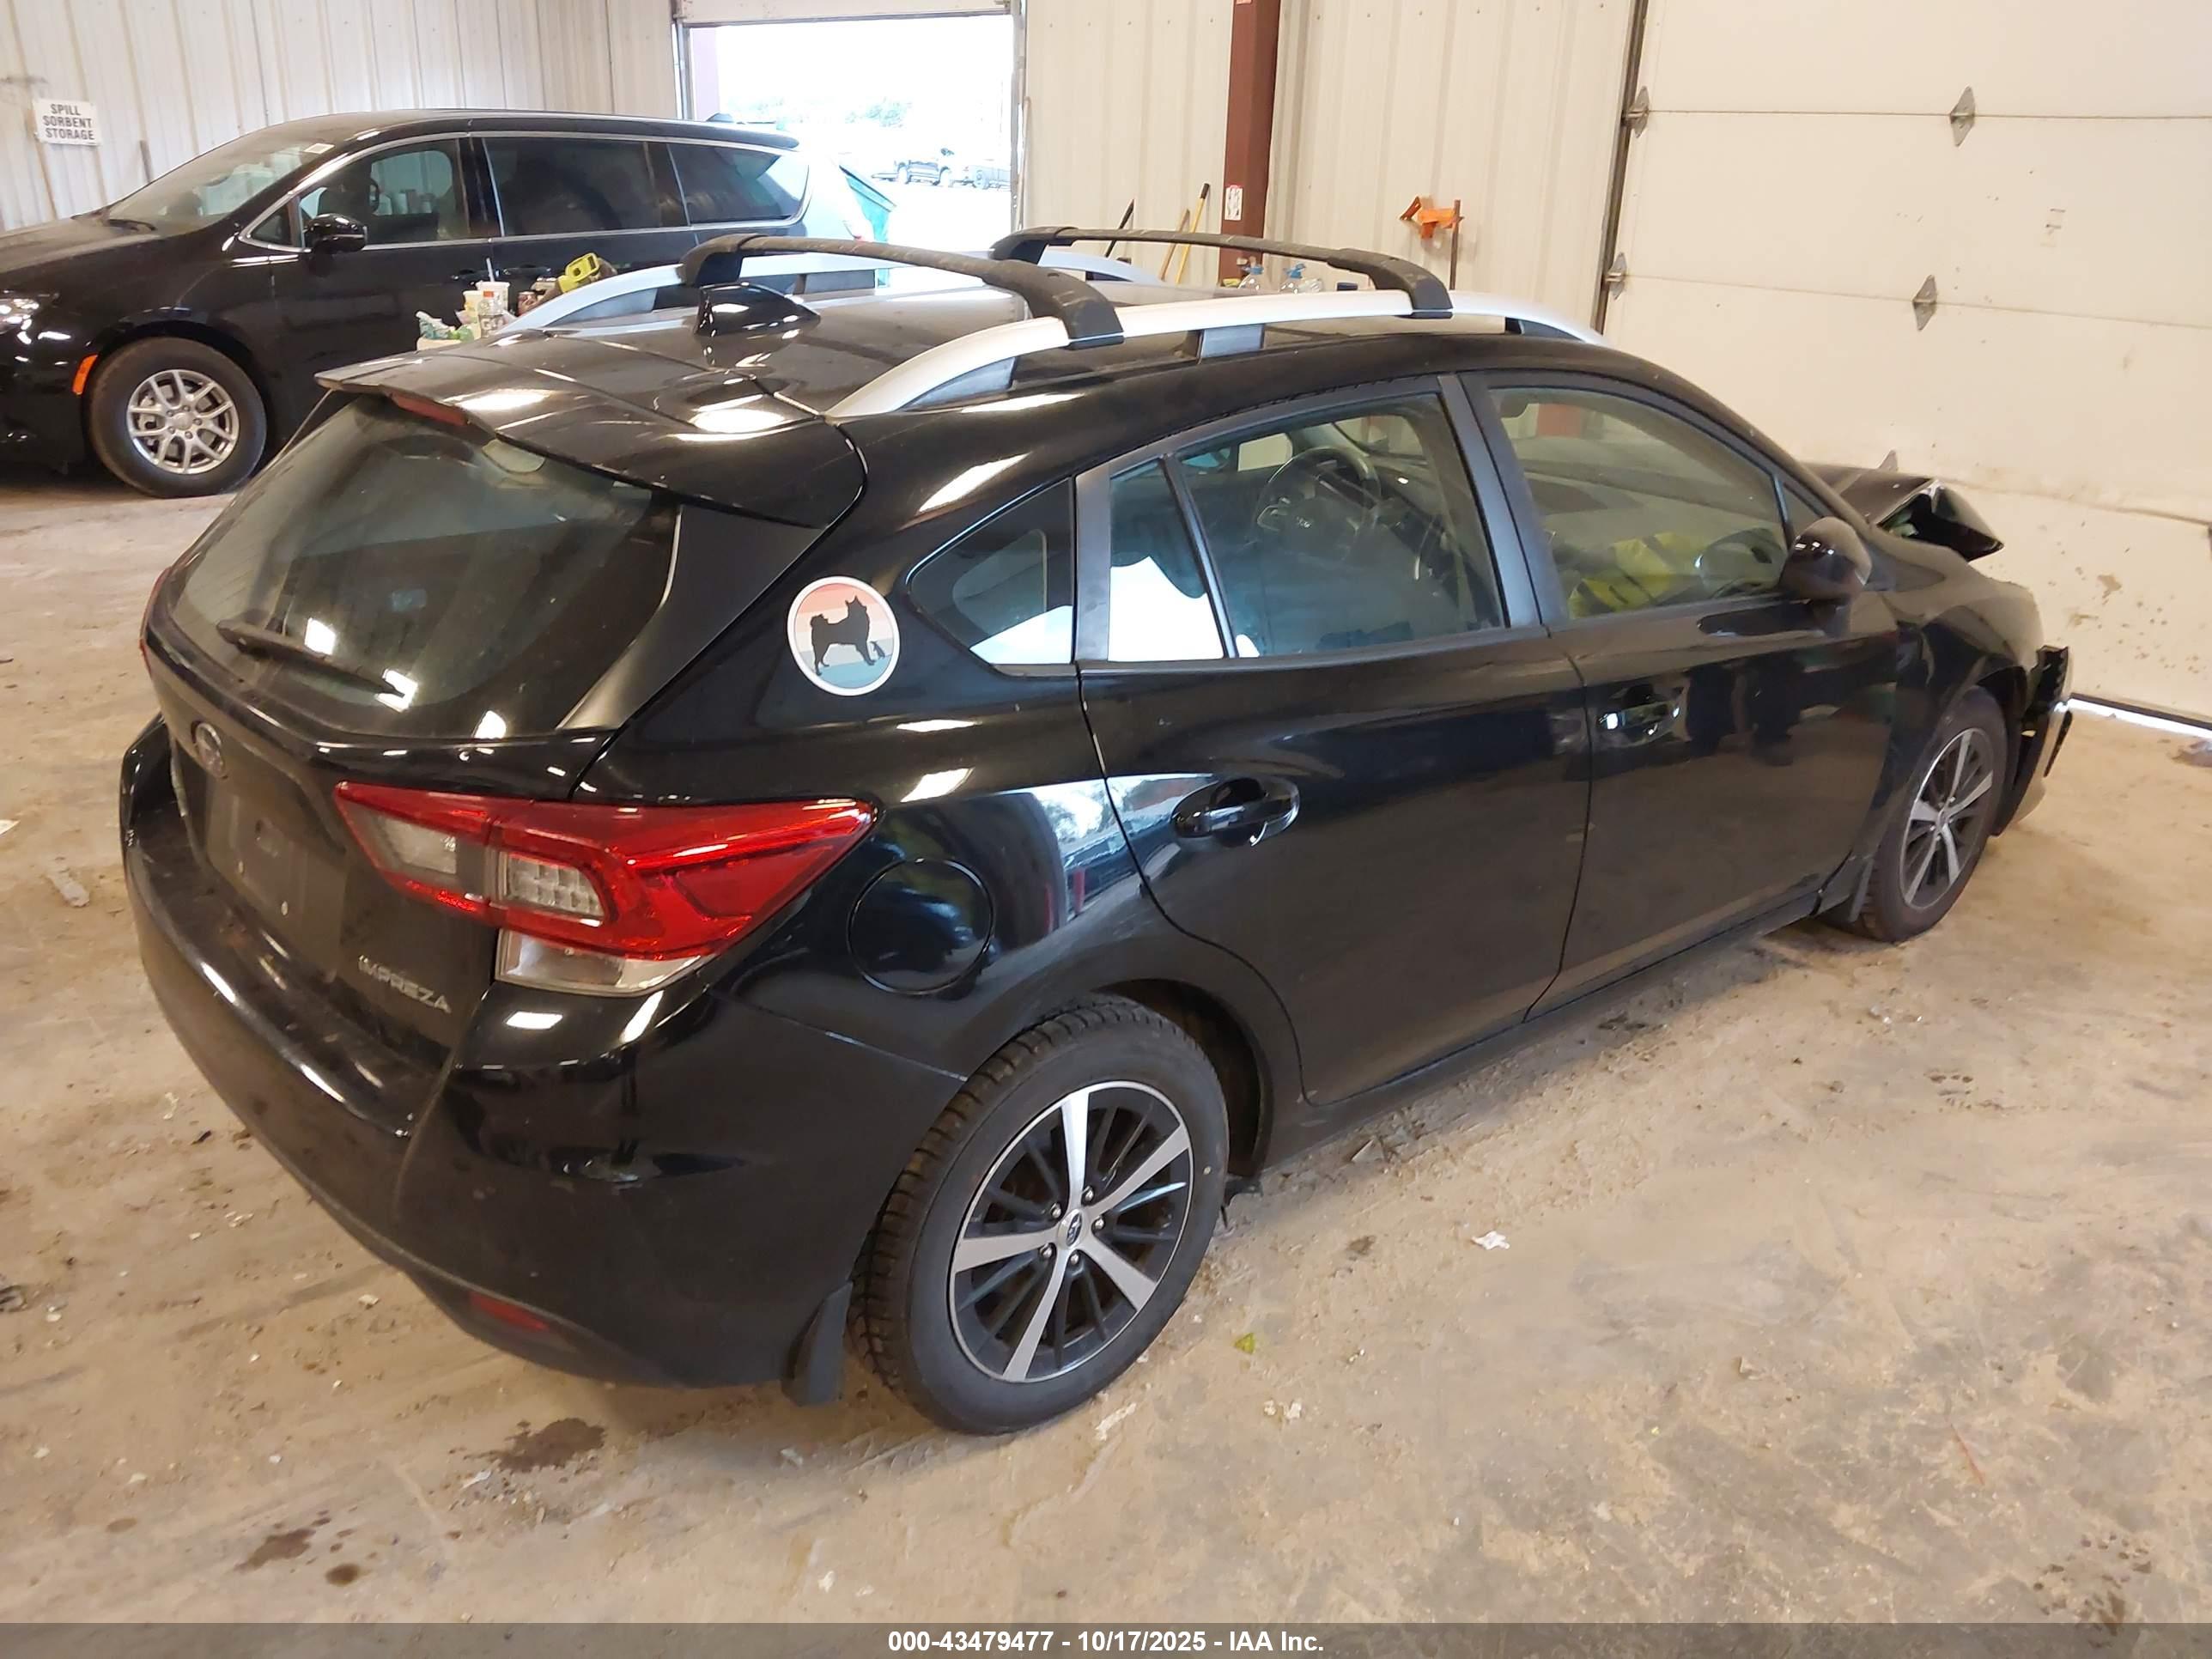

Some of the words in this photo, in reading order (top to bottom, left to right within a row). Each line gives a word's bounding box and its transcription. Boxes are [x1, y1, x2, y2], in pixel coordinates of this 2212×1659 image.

[50, 103, 82, 116] SPILL
[42, 115, 92, 128] SORBENT
[45, 127, 95, 140] STORAGE
